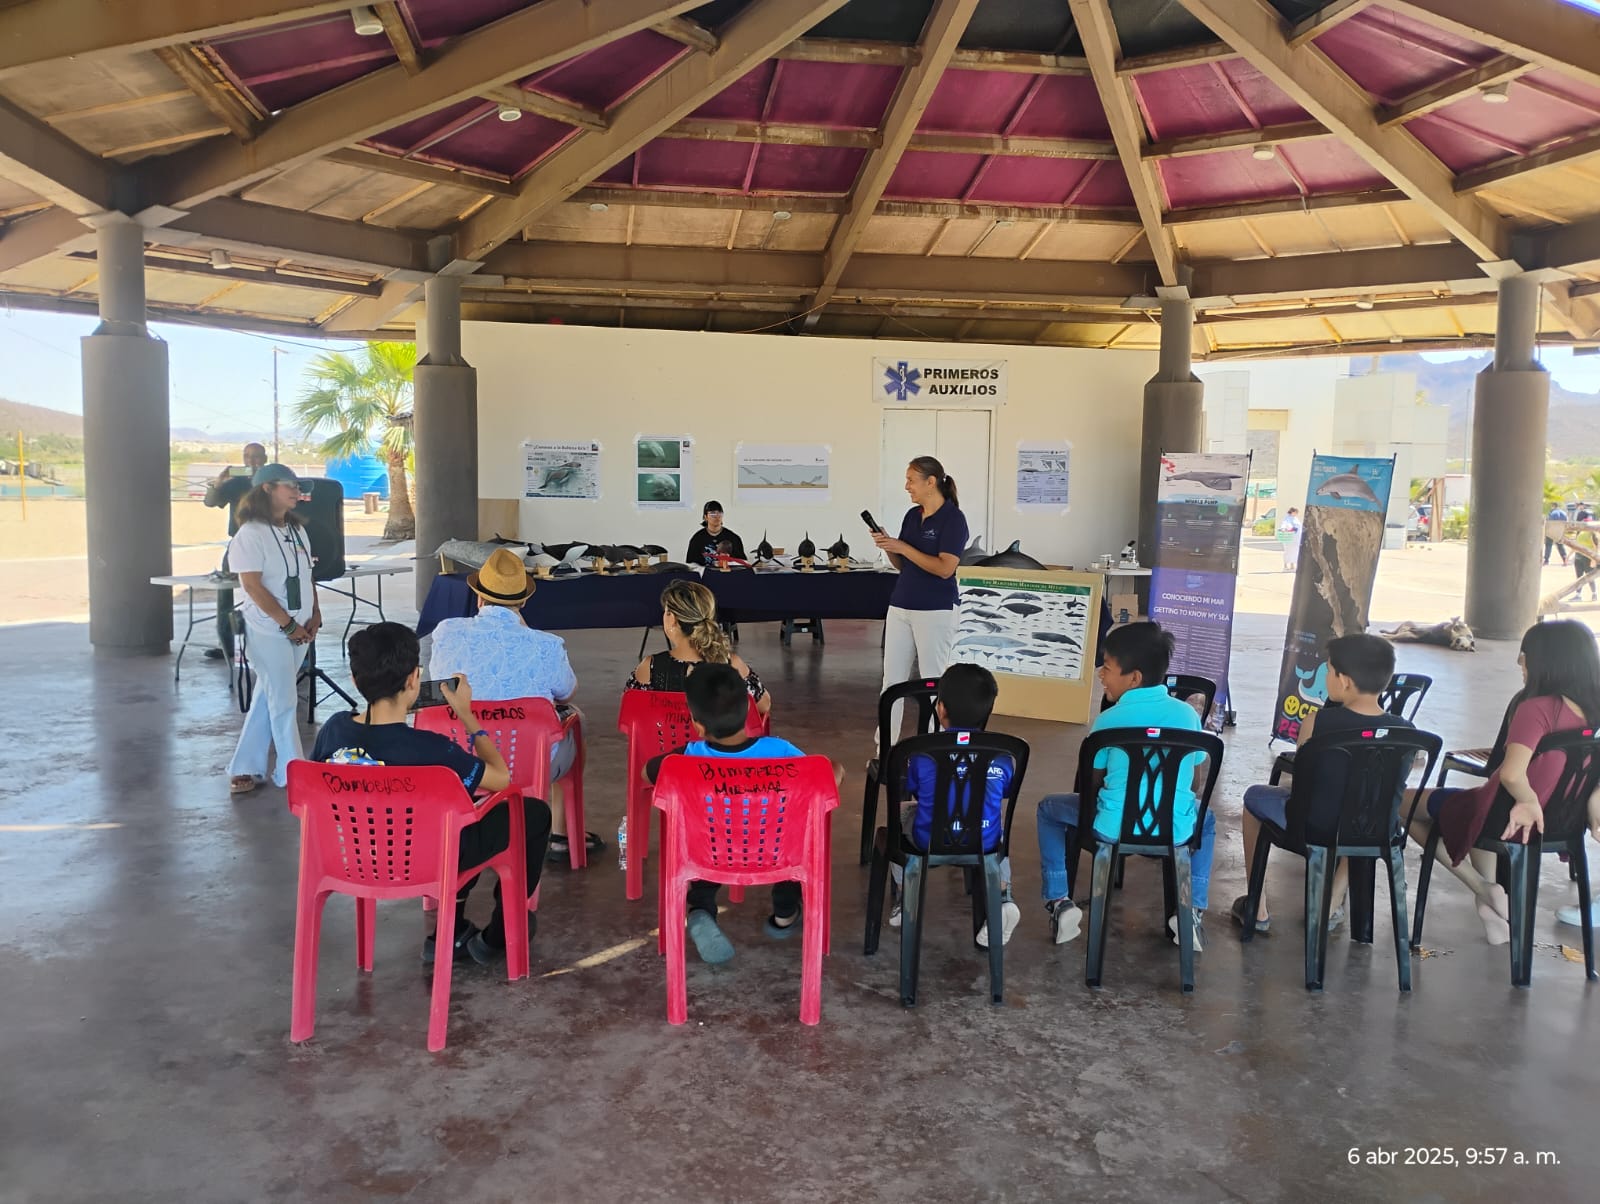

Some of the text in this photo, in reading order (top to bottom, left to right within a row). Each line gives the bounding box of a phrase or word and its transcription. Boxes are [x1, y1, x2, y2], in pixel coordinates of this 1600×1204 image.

[923, 368, 999, 379] PRIMEROS
[928, 384, 997, 395] AUXILIOS
[1162, 593, 1202, 603] CONOCIENDO
[1154, 606, 1179, 615] GETTING
[1188, 610, 1207, 618] KNOW
[1208, 612, 1217, 620] MY
[1218, 613, 1230, 621] SEA
